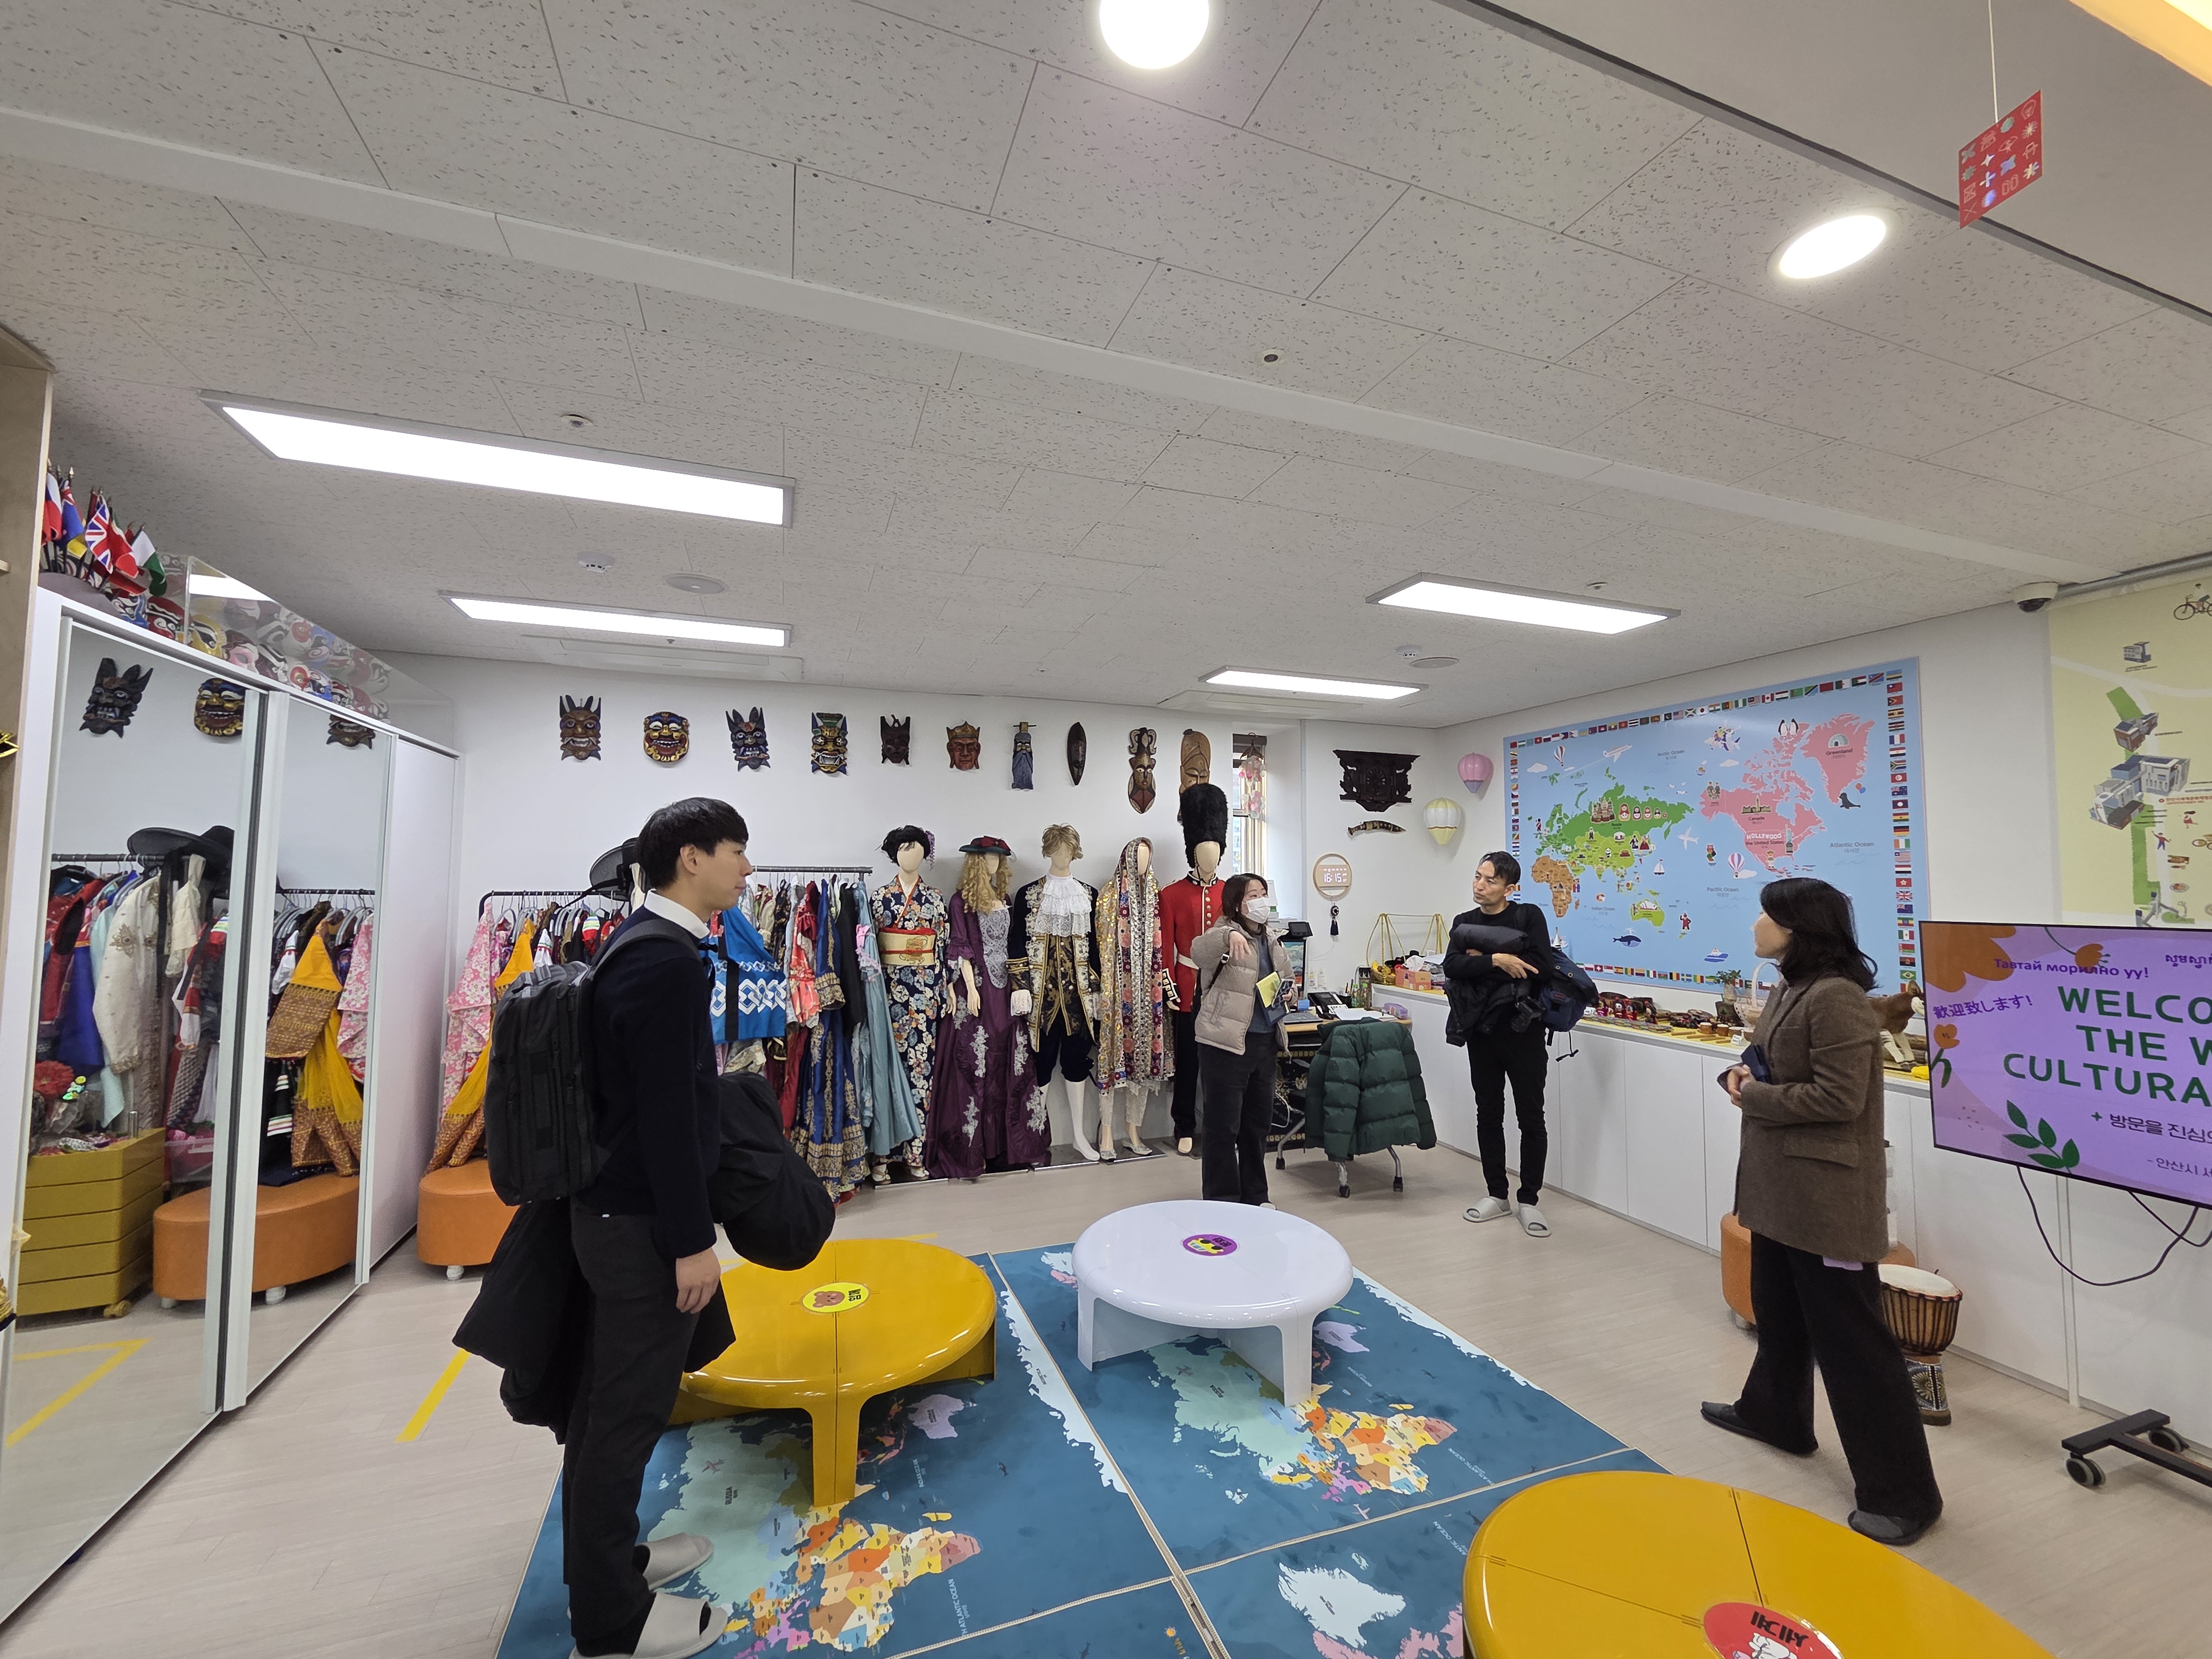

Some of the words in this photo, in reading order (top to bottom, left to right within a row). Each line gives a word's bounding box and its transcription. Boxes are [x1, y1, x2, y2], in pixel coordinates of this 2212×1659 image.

[1994, 958, 2042, 971] Тавтай
[2047, 964, 2119, 976] морилно
[2124, 967, 2149, 980] уу!
[2057, 986, 2212, 1025] WELCO
[2075, 1025, 2167, 1061] THE
[2004, 1053, 2212, 1107] CULTURA
[2110, 1114, 2163, 1135] 방문을
[1433, 1521, 1452, 1540] OCEAN
[948, 1578, 958, 1599] OCEAN
[953, 1599, 967, 1627] ATLANTIC
